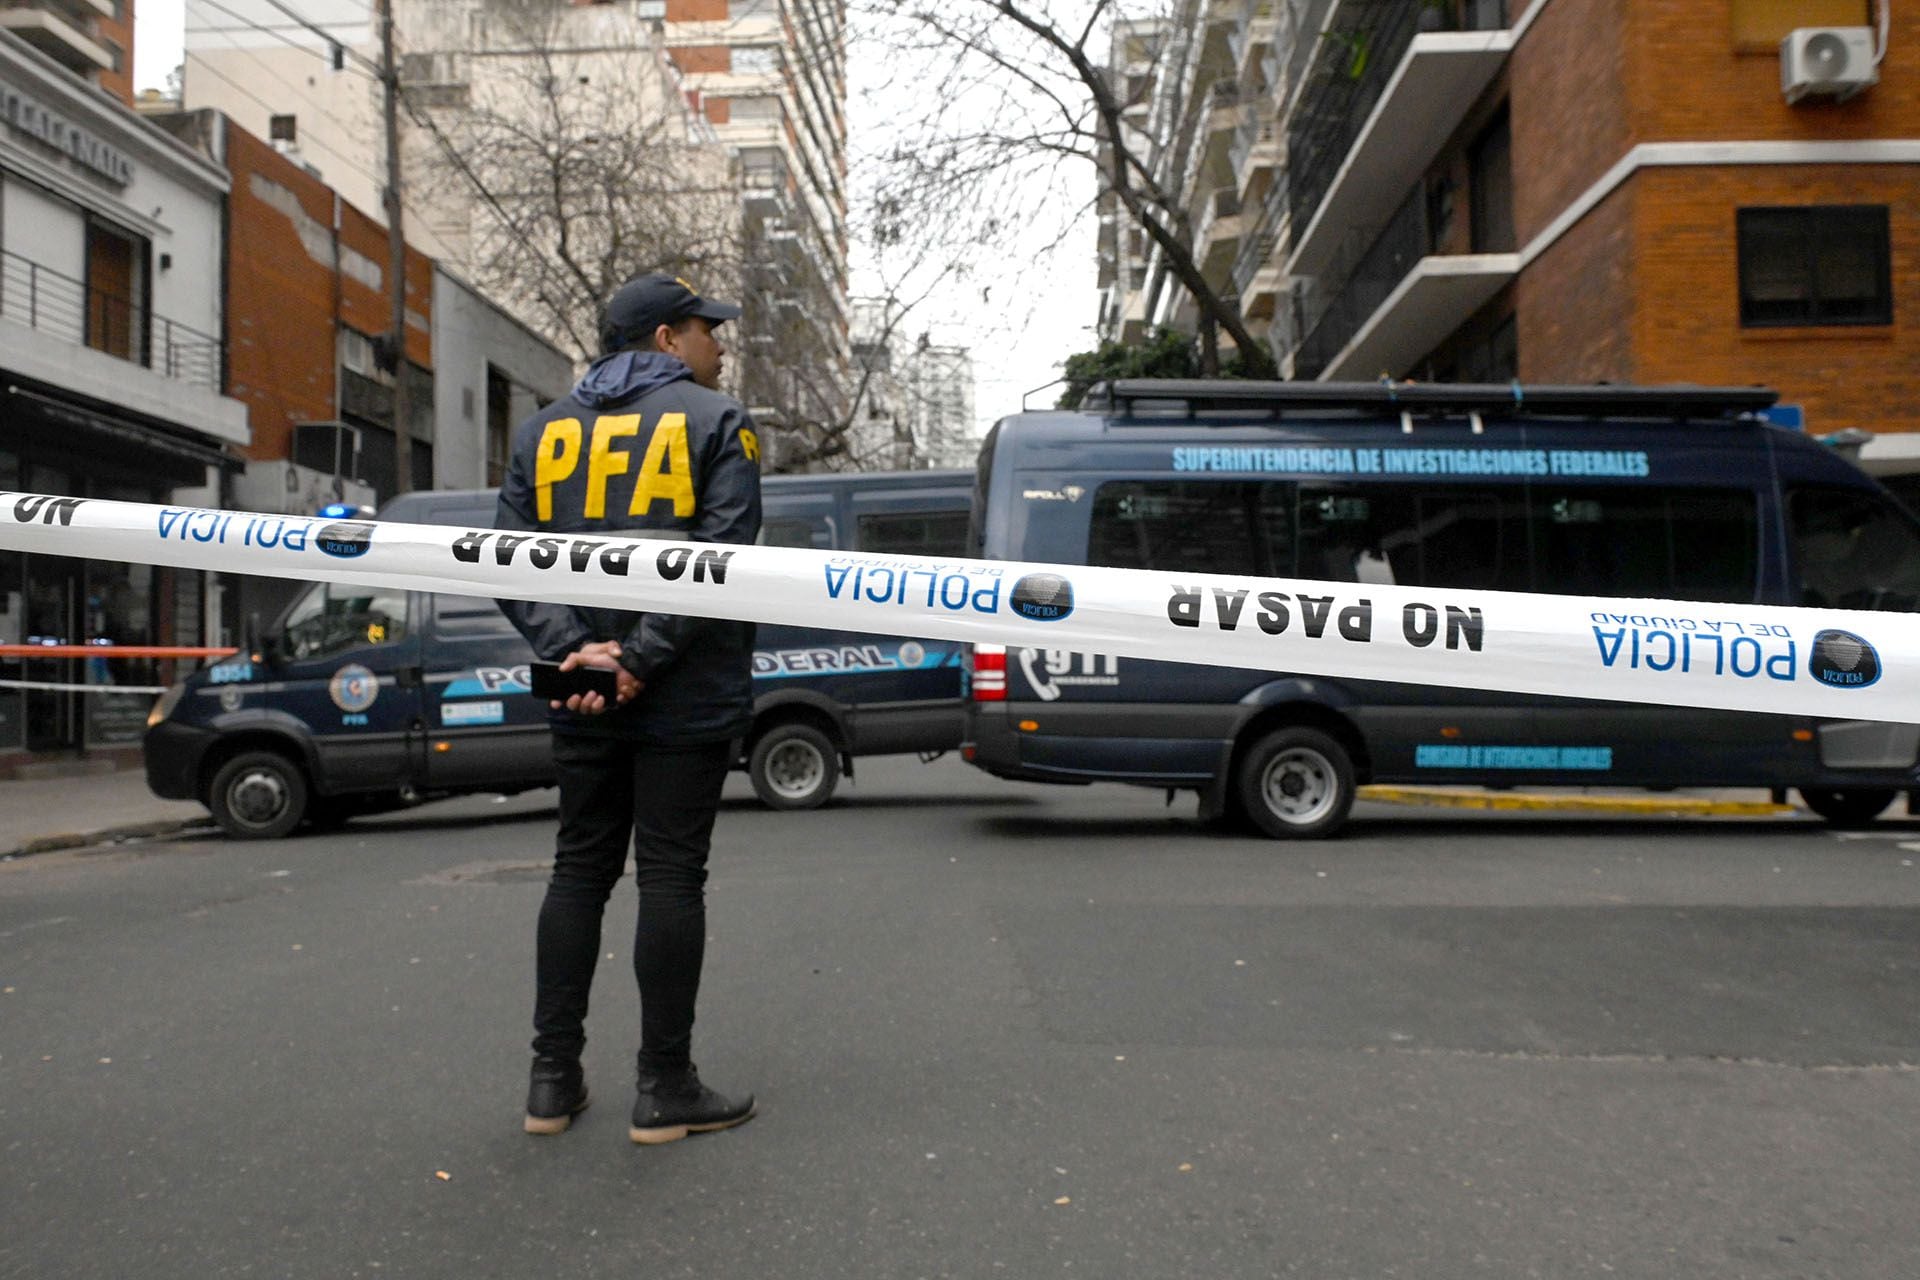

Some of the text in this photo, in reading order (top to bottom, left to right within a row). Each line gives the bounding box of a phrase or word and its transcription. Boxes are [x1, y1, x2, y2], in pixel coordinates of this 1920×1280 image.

[535, 412, 696, 522] PFA
[1172, 446, 1650, 477] SUPERINTENDENCIA DE INVESTIGACIONES FEDERALES
[13, 496, 89, 526] NO
[158, 509, 314, 552] POLICIA
[325, 541, 357, 554] POLICIA
[451, 532, 736, 585] NO PASAR
[932, 563, 964, 574] LA
[973, 566, 1004, 577] DE
[823, 563, 1001, 614] POLICIA
[1022, 602, 1059, 617] POLICIA
[1167, 584, 1483, 652] NO PASAR
[1590, 612, 1791, 639] DE LA CIUDAD
[753, 645, 895, 675] DERAL
[1591, 625, 1797, 682] POLICIA
[1822, 668, 1863, 684] POLICIA
